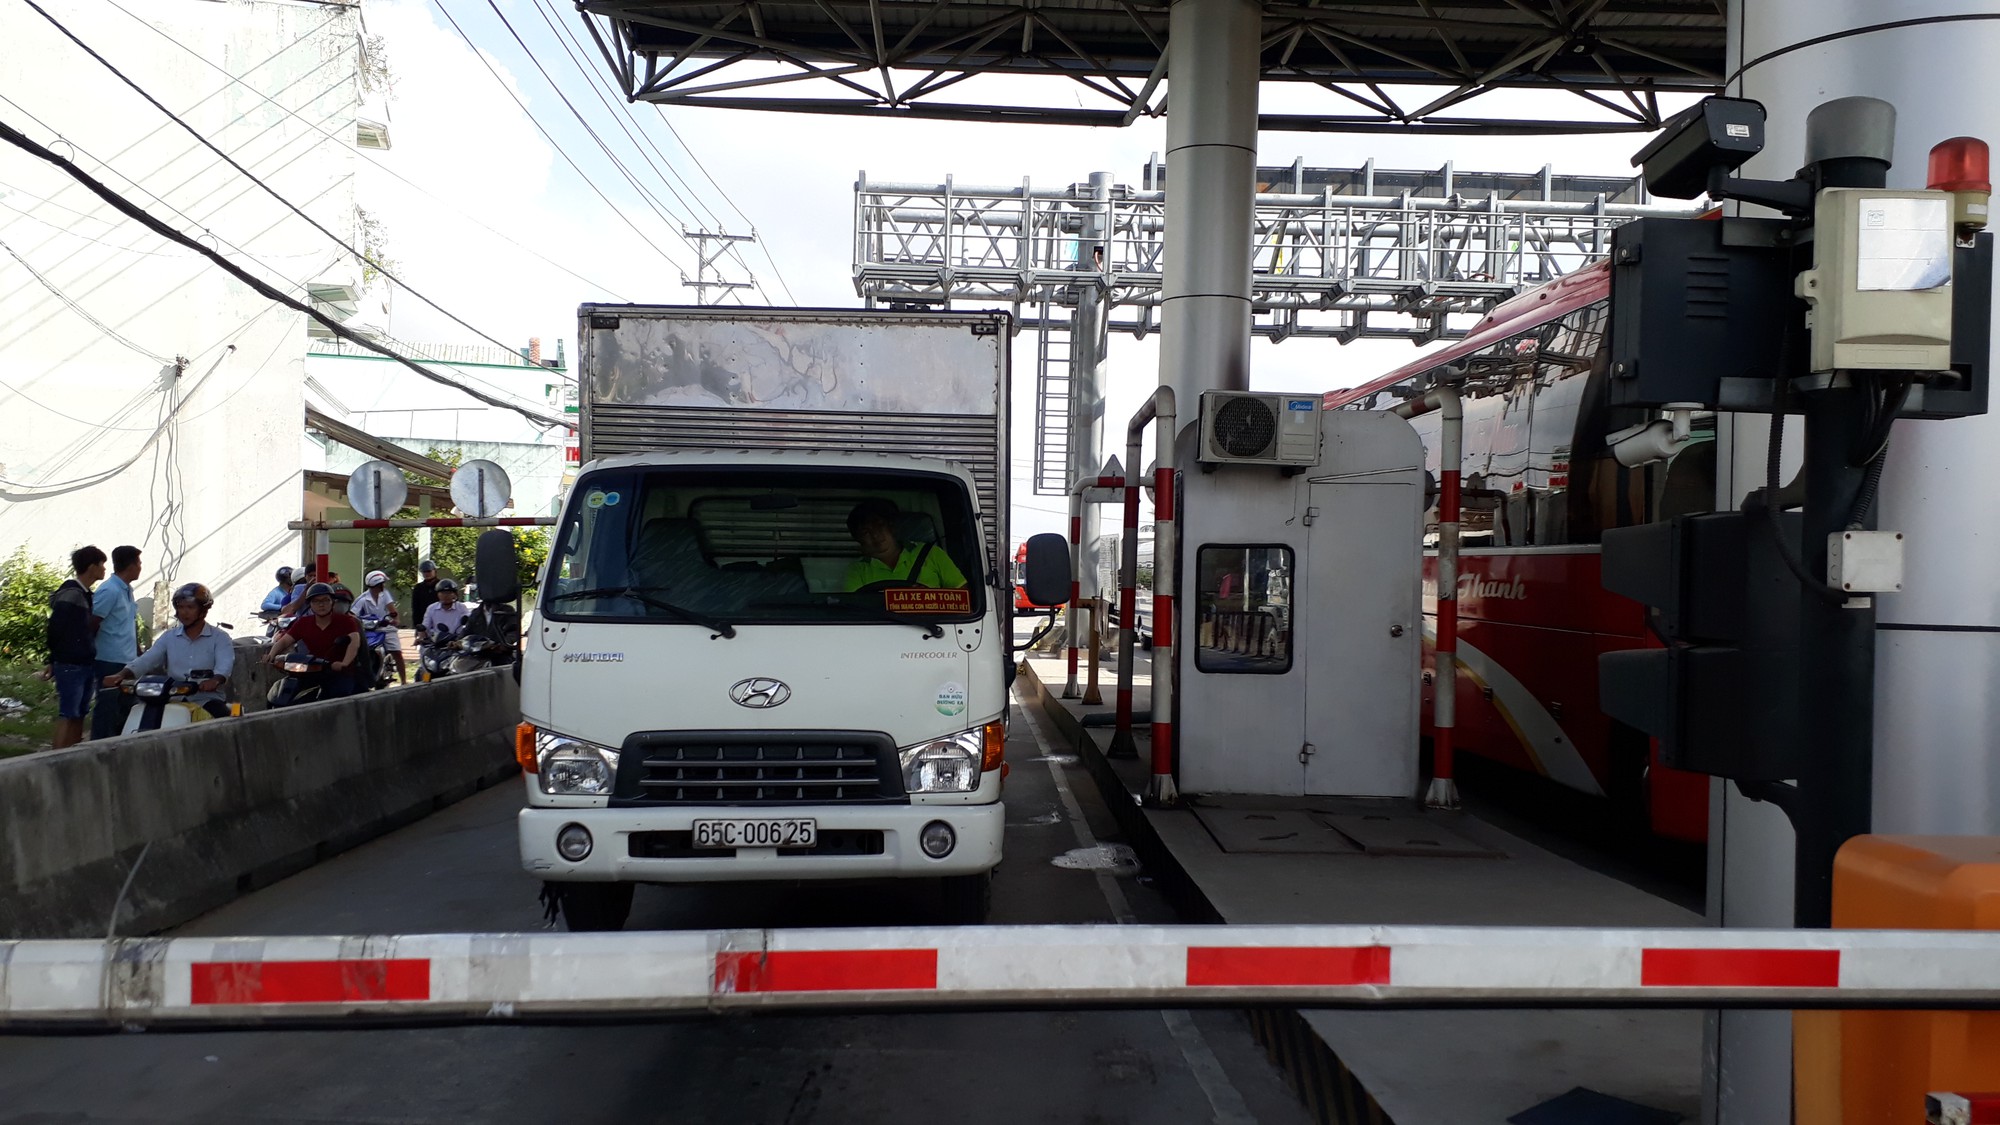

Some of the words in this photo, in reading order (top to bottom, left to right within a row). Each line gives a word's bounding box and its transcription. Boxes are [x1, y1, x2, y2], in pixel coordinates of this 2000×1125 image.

[893, 592, 908, 601] LÁI
[910, 593, 922, 601] XE
[924, 593, 936, 601] AN
[938, 592, 962, 601] TOÀN
[563, 652, 624, 663] HYUNDAI
